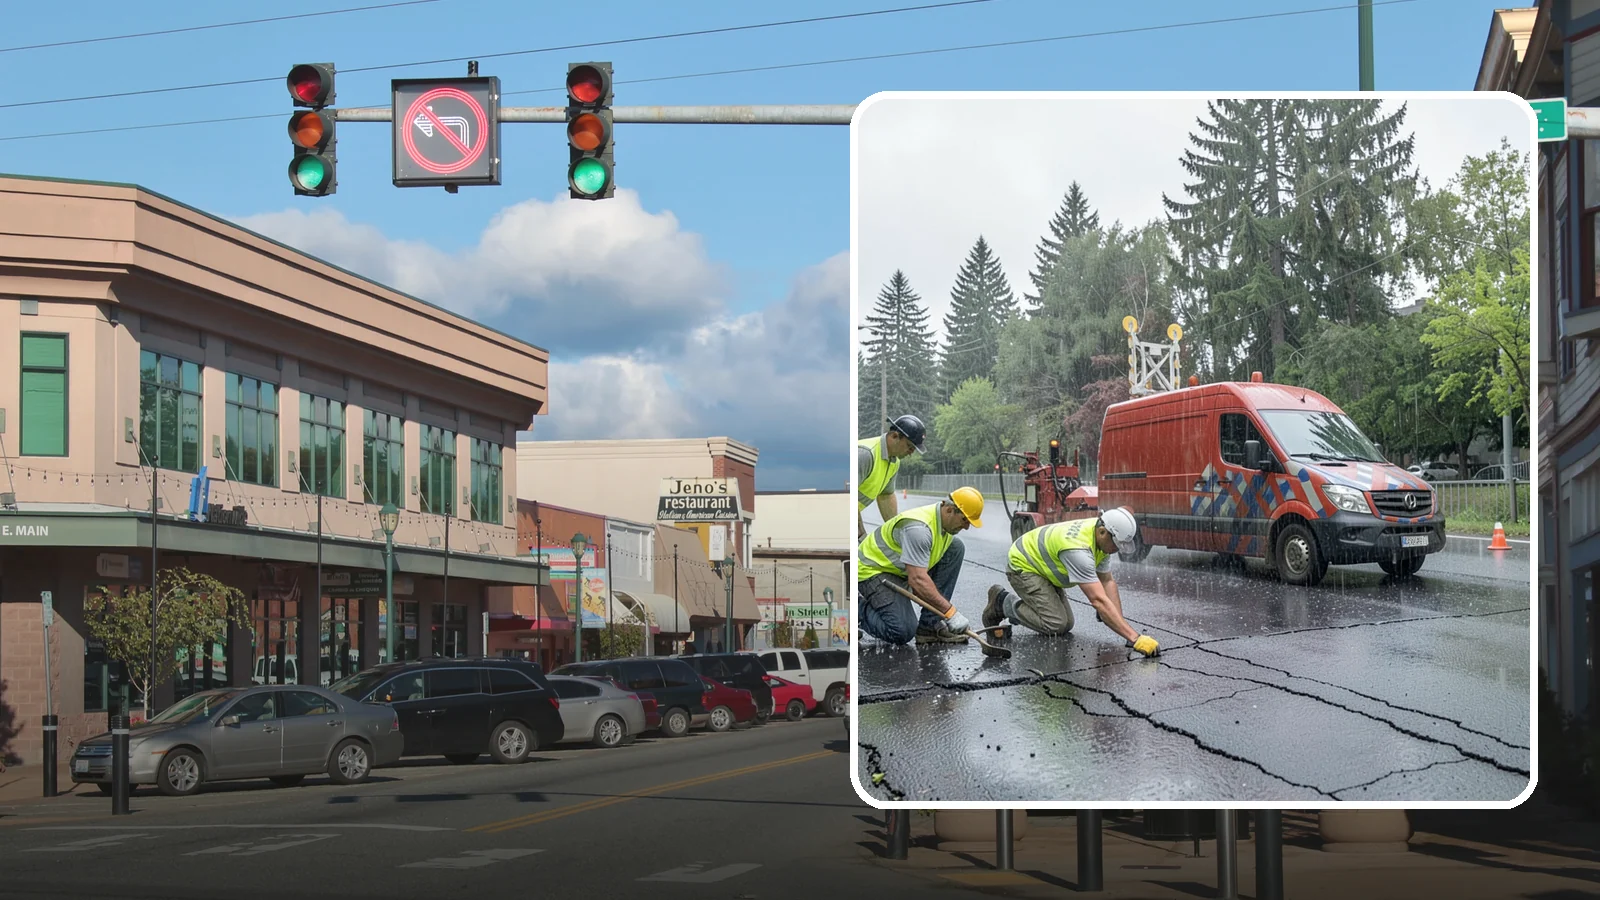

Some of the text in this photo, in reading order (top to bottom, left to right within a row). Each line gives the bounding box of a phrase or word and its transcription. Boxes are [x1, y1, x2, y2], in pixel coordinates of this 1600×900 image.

[670, 480, 728, 494] Jeno's
[665, 497, 731, 509] restaurant
[659, 510, 682, 519] Italian
[686, 510, 715, 519] American
[715, 509, 738, 519] Cuisine
[2, 525, 49, 536] E. MAIN
[797, 607, 828, 616] Street
